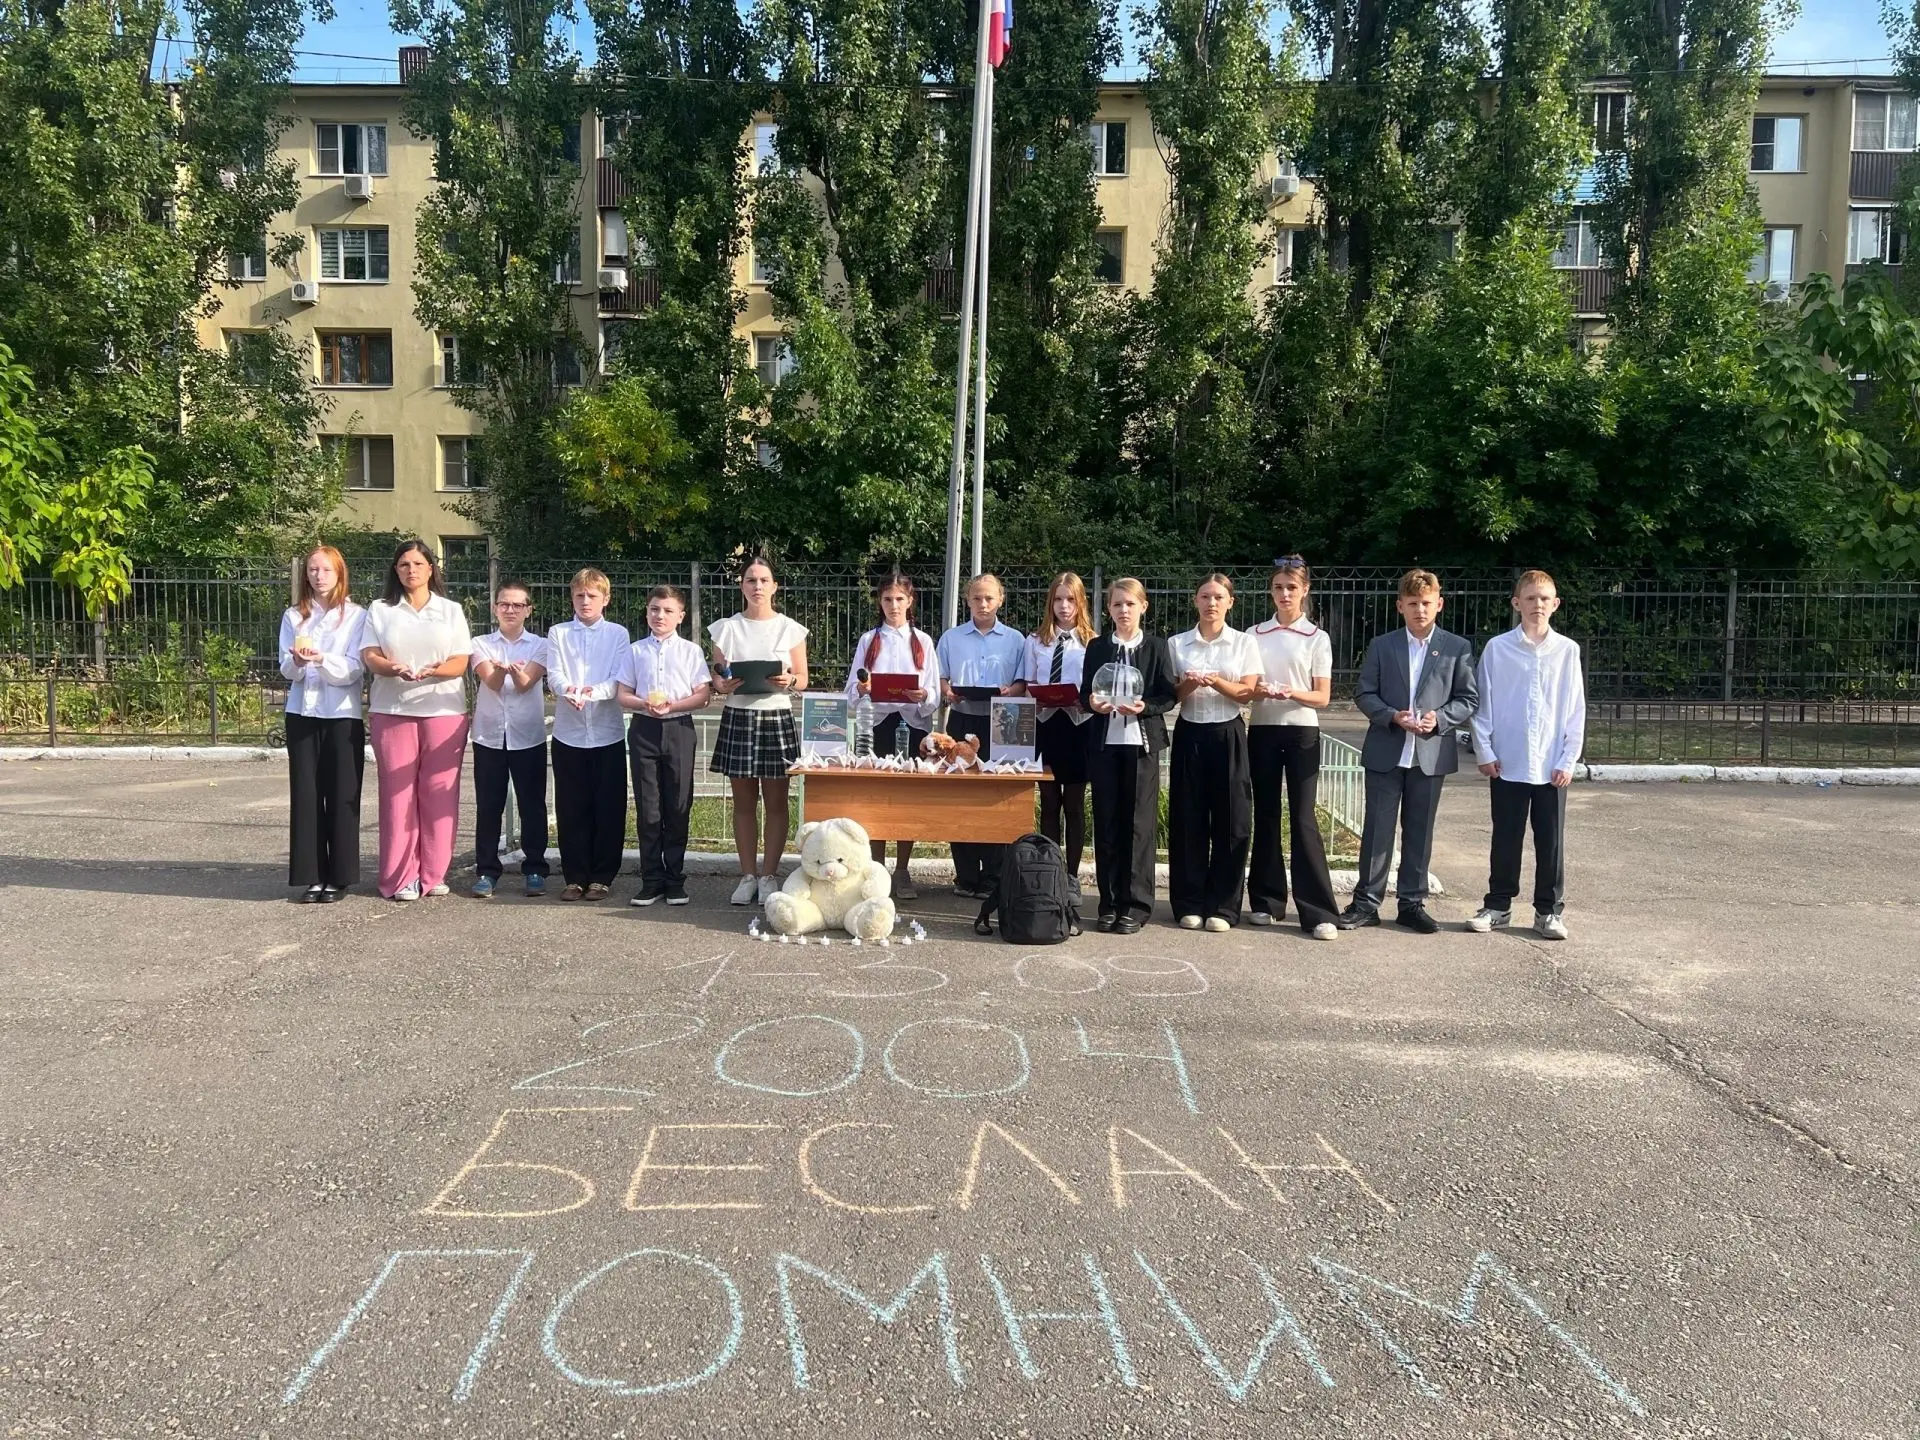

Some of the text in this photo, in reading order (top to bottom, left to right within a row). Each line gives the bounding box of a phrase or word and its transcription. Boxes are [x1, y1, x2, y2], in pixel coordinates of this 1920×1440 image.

[510, 1012, 1201, 1115] 2004
[421, 1106, 1397, 1218] БЕСЛАН
[283, 1247, 1648, 1417] ПОМНИМ
